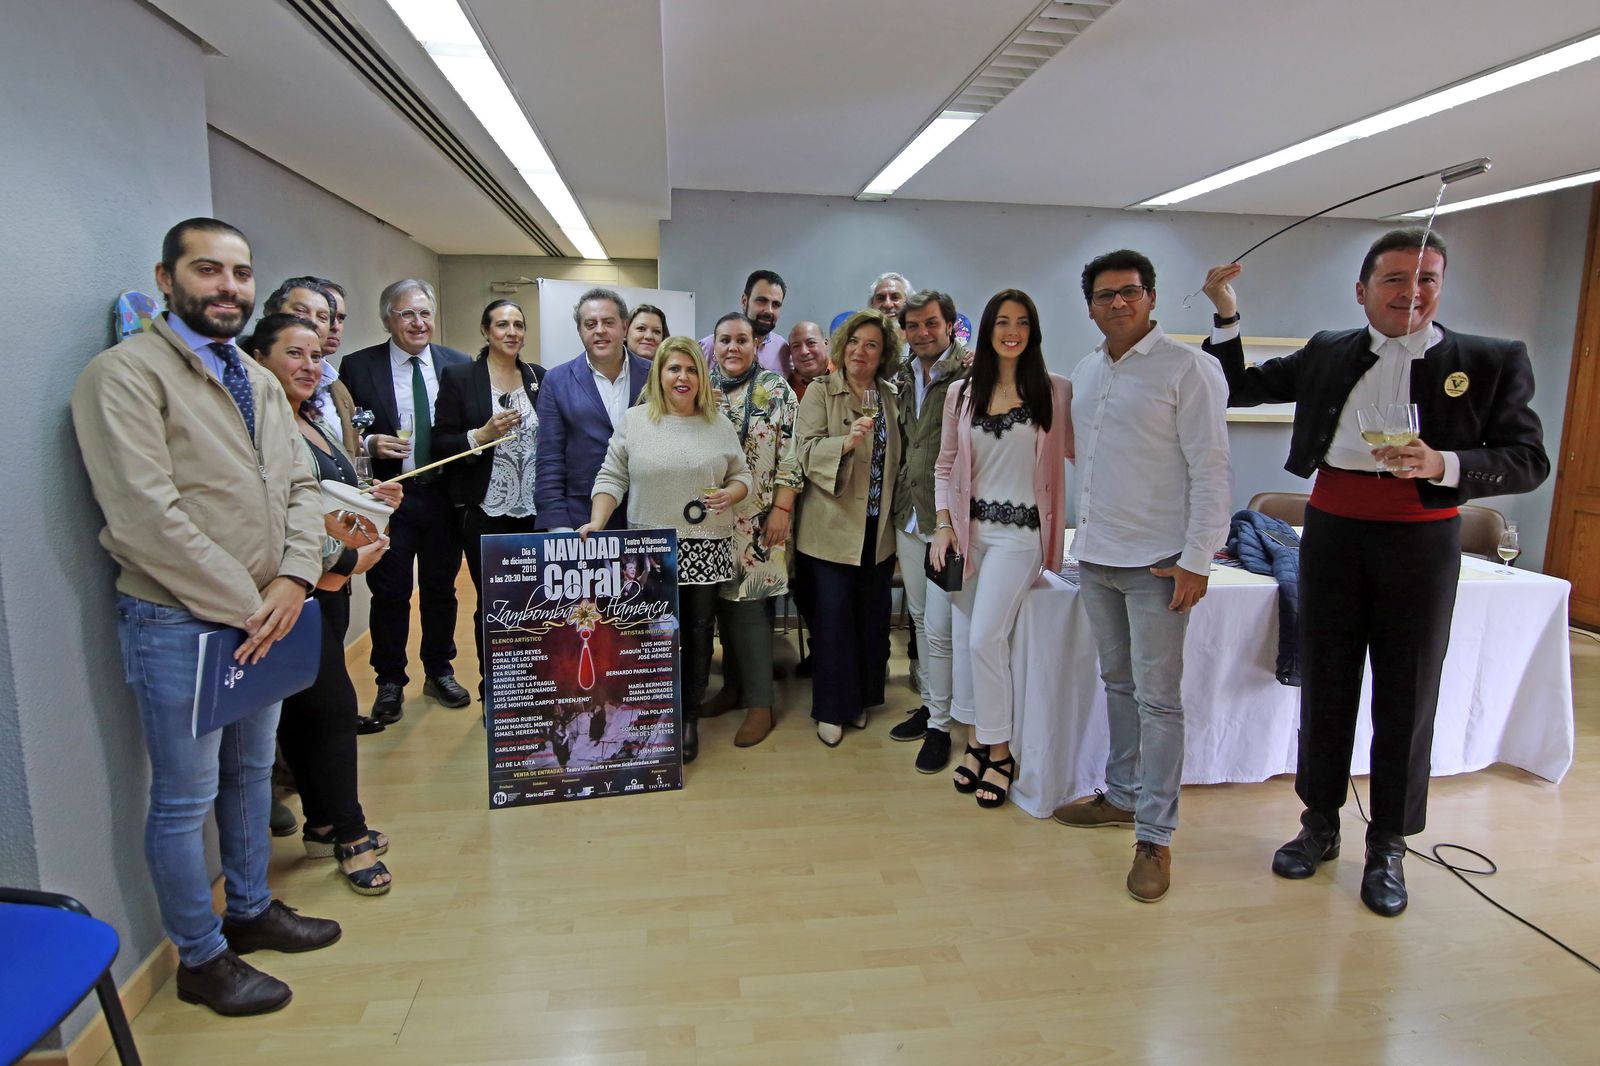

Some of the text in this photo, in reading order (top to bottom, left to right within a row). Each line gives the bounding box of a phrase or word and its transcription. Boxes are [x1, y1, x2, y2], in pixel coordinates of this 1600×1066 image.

[544, 537, 619, 562] NAVIDAD
[578, 560, 587, 570] de
[504, 574, 520, 582] 20:30
[544, 561, 622, 601] Coral
[487, 581, 673, 627] Zambomba Flamenca
